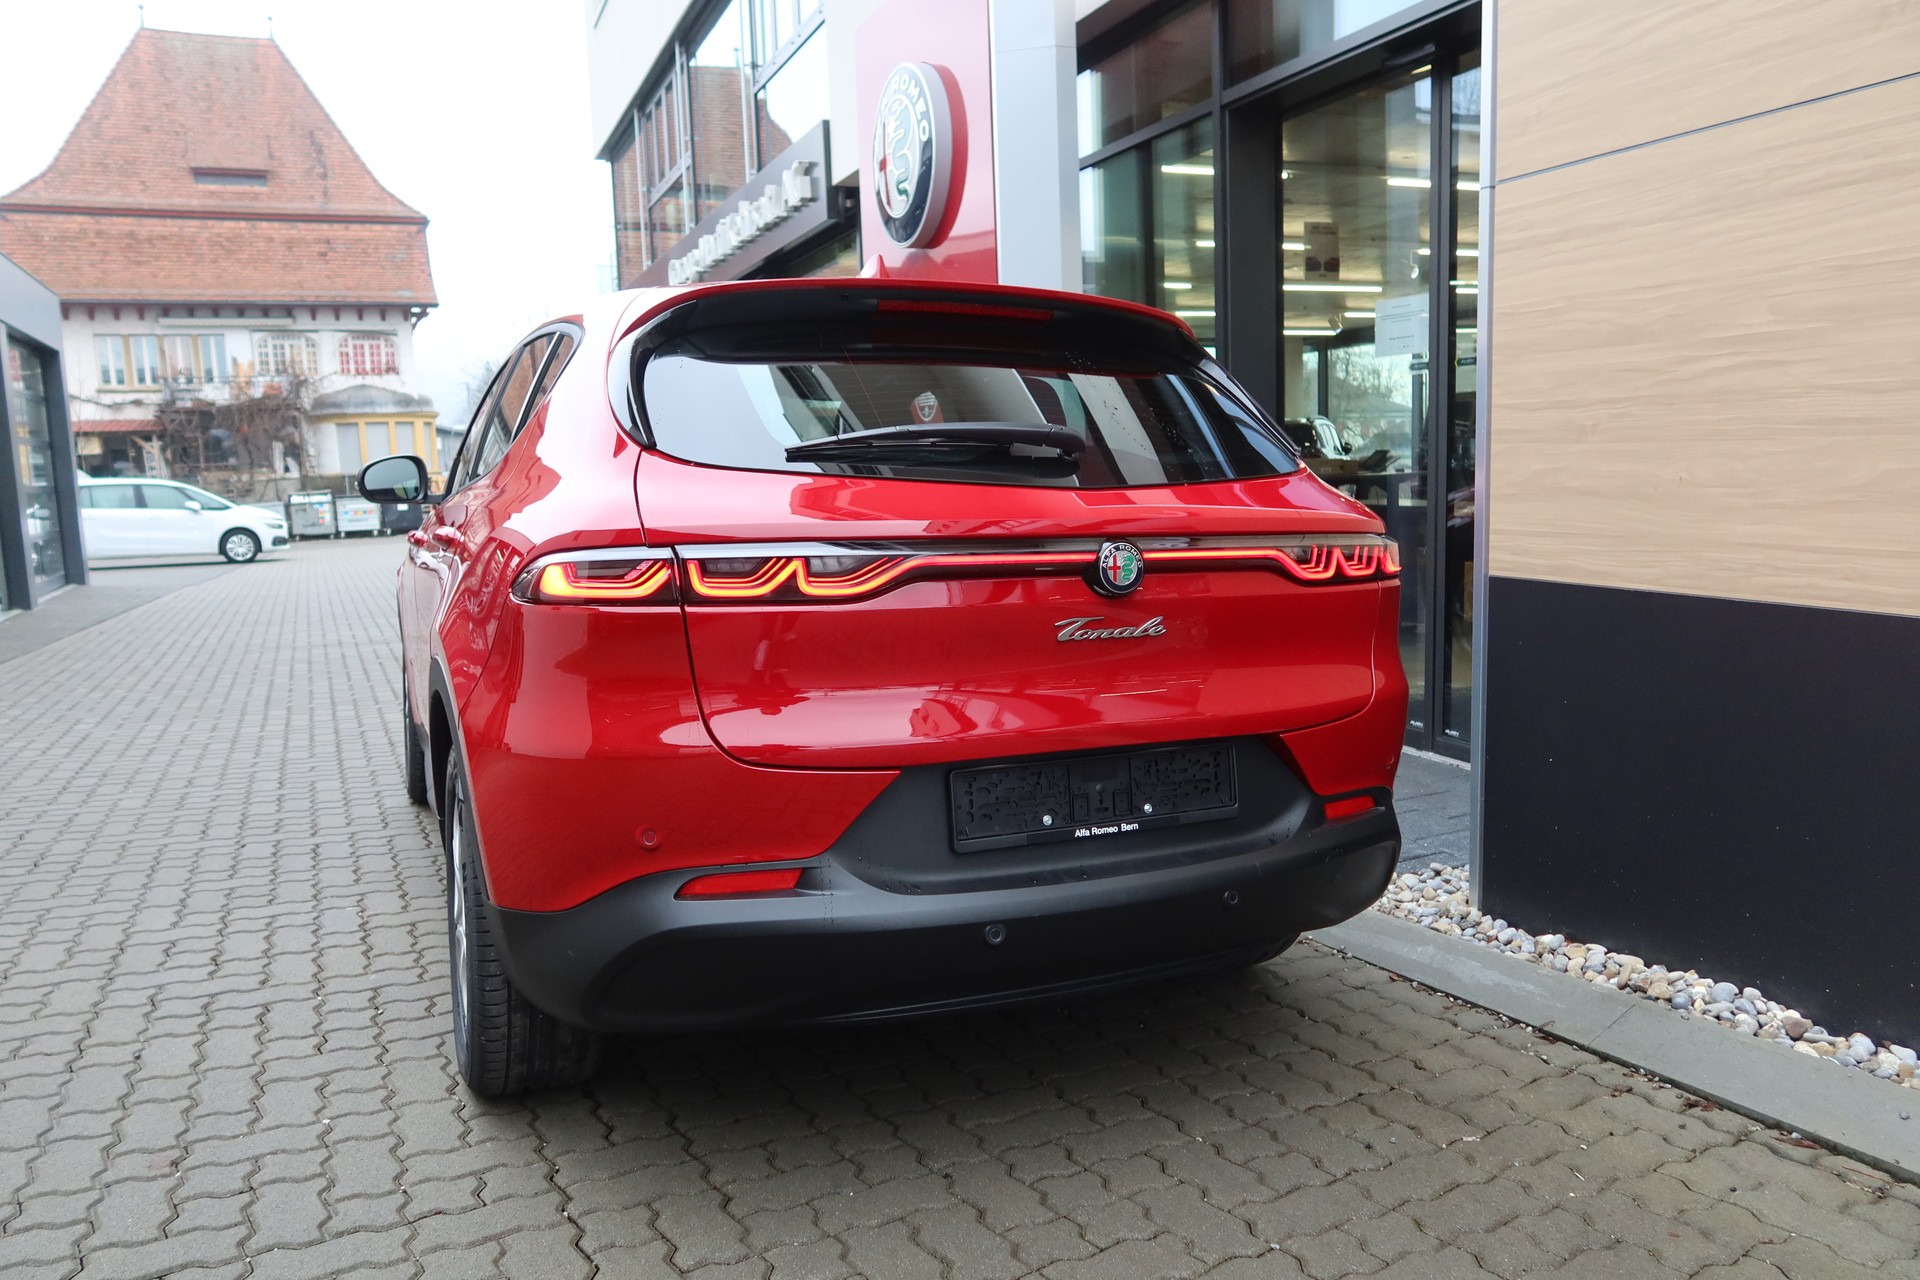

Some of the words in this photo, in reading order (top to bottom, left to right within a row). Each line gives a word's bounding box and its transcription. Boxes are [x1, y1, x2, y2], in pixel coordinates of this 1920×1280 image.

[892, 74, 929, 142] ROMEO
[1102, 547, 1116, 568] ALFA
[1120, 544, 1142, 568] ROMEO
[1054, 616, 1166, 642] Tonale
[1075, 829, 1090, 838] Alfa
[1091, 826, 1118, 836] Romeo
[1121, 823, 1139, 832] Bern
